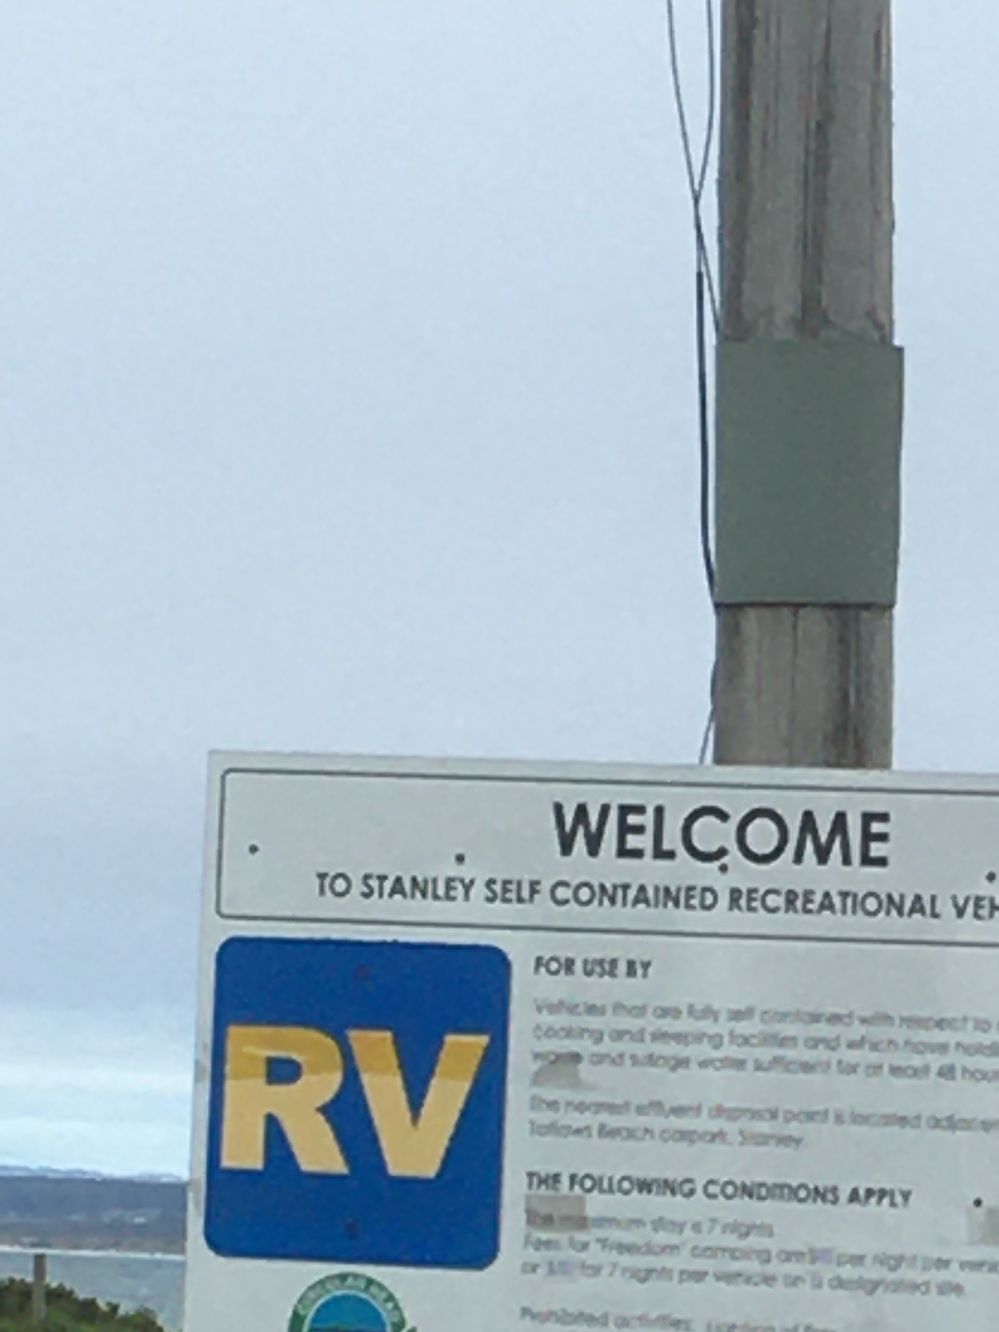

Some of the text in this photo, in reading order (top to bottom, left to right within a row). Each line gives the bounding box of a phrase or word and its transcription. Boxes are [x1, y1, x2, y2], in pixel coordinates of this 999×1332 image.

[553, 801, 891, 867] WELCOME
[315, 872, 352, 899] TO
[360, 874, 475, 903] STANLEY
[484, 877, 541, 905] SELF
[549, 879, 719, 912] CONTAINED
[727, 886, 941, 920] RECREATIONAL
[534, 956, 652, 978] FOR USE BY
[652, 1006, 682, 1019] are
[220, 1024, 491, 1180] RV
[526, 1171, 913, 1208] THE FOLLOWING CONDITIONS APPLY
